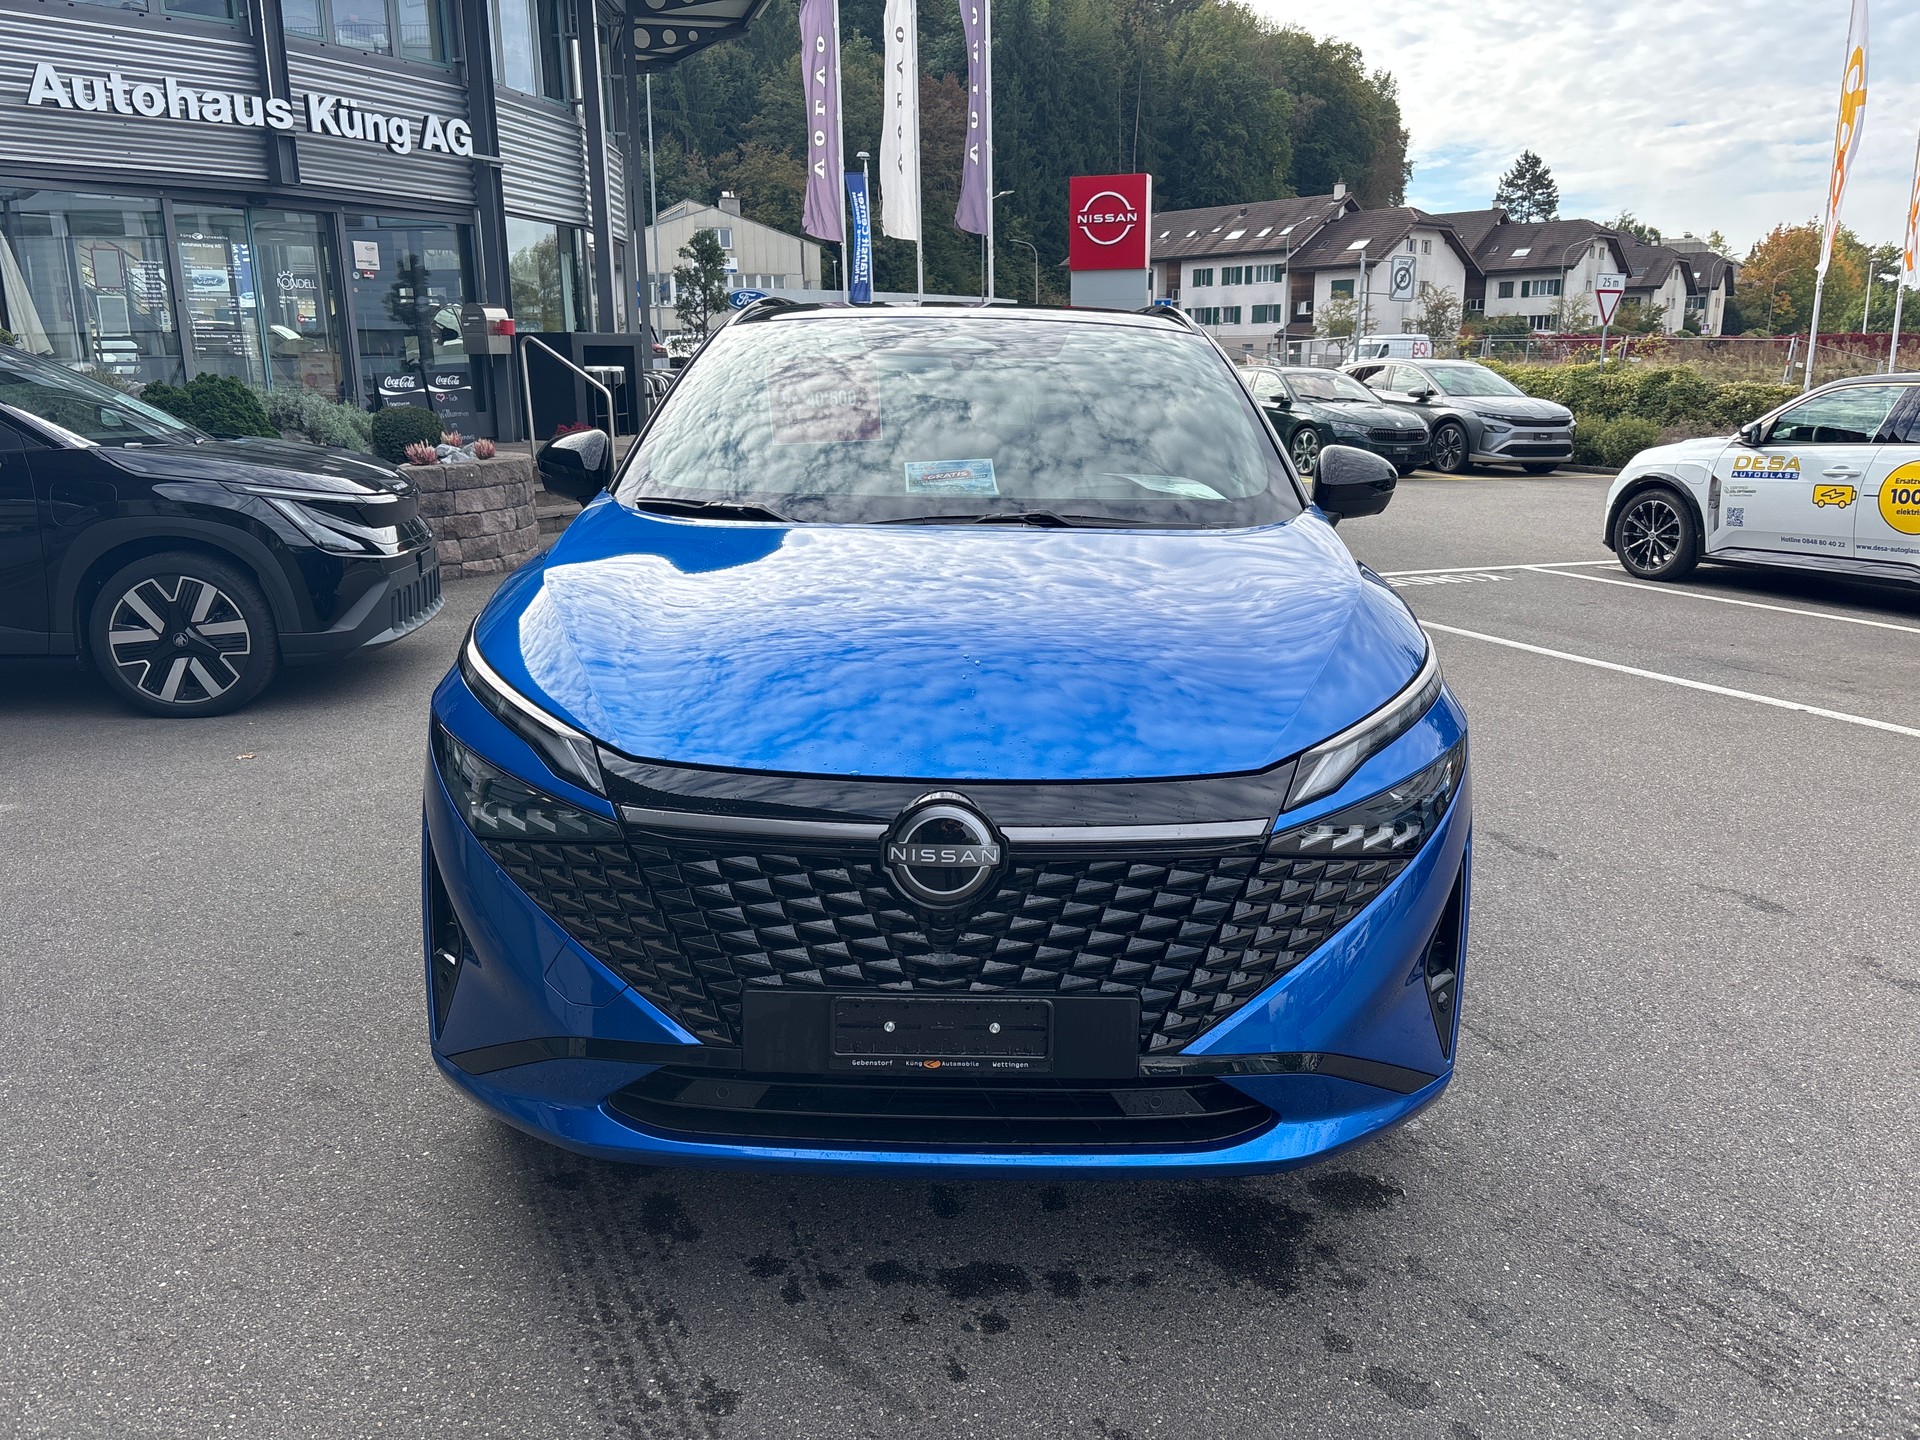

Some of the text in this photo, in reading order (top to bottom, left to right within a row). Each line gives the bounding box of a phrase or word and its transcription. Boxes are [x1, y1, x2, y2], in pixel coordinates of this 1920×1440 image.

[27, 62, 475, 157] Autohaus Küng AG
[1077, 212, 1137, 224] NISSAN
[1602, 277, 1612, 287] 25
[1733, 454, 1801, 472] DESA
[927, 470, 968, 480] GRATIS
[1732, 471, 1800, 479] AUTOGLASS
[1891, 488, 1920, 505] 100
[1780, 536, 1801, 544] Hotline
[1802, 537, 1818, 545] 0848
[1818, 538, 1827, 546] 80
[1828, 539, 1837, 547] 40
[890, 845, 997, 863] NISSAN
[992, 1061, 1029, 1069] Wettingen
